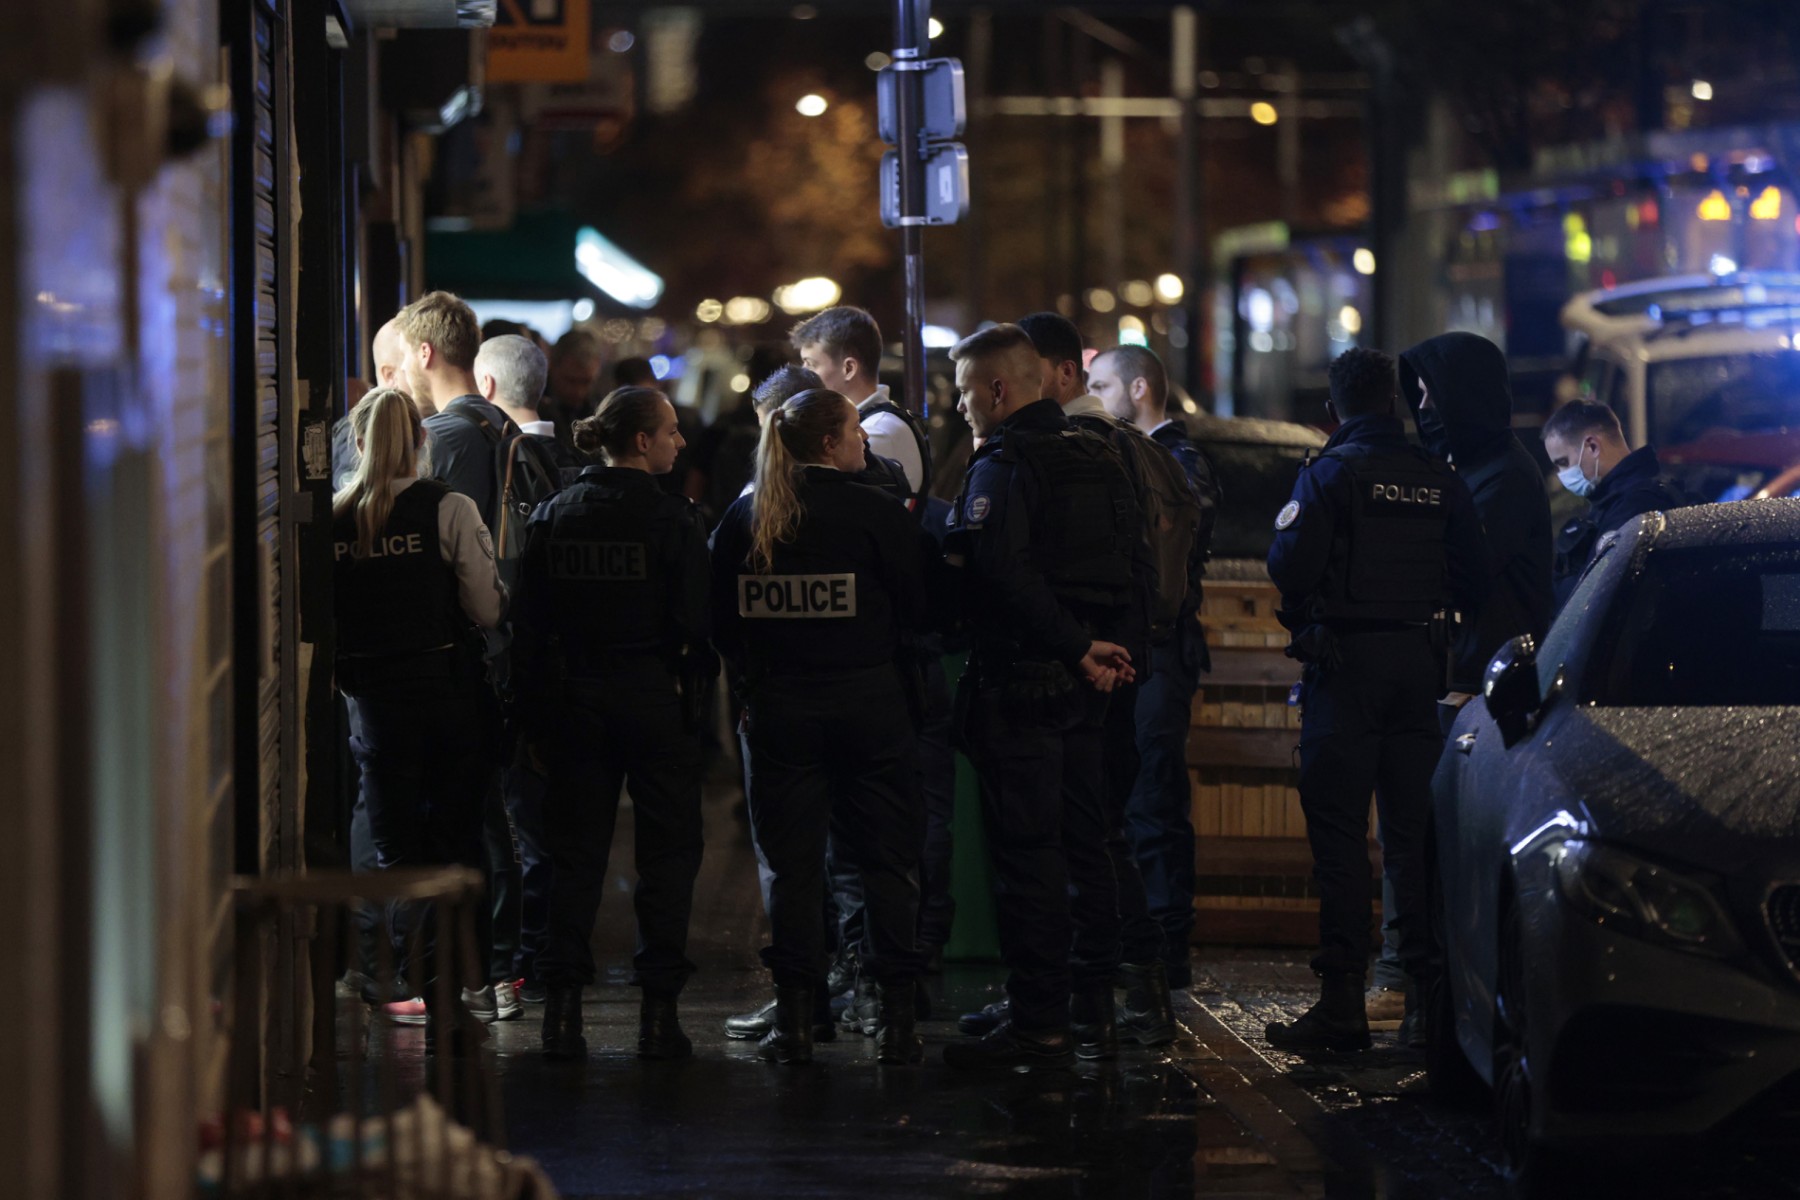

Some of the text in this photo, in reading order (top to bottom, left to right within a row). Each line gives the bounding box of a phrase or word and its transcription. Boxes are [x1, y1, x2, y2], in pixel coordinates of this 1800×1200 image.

[1373, 484, 1441, 505] POLICE
[550, 544, 641, 576] POLICE
[745, 580, 848, 612] POLICE
